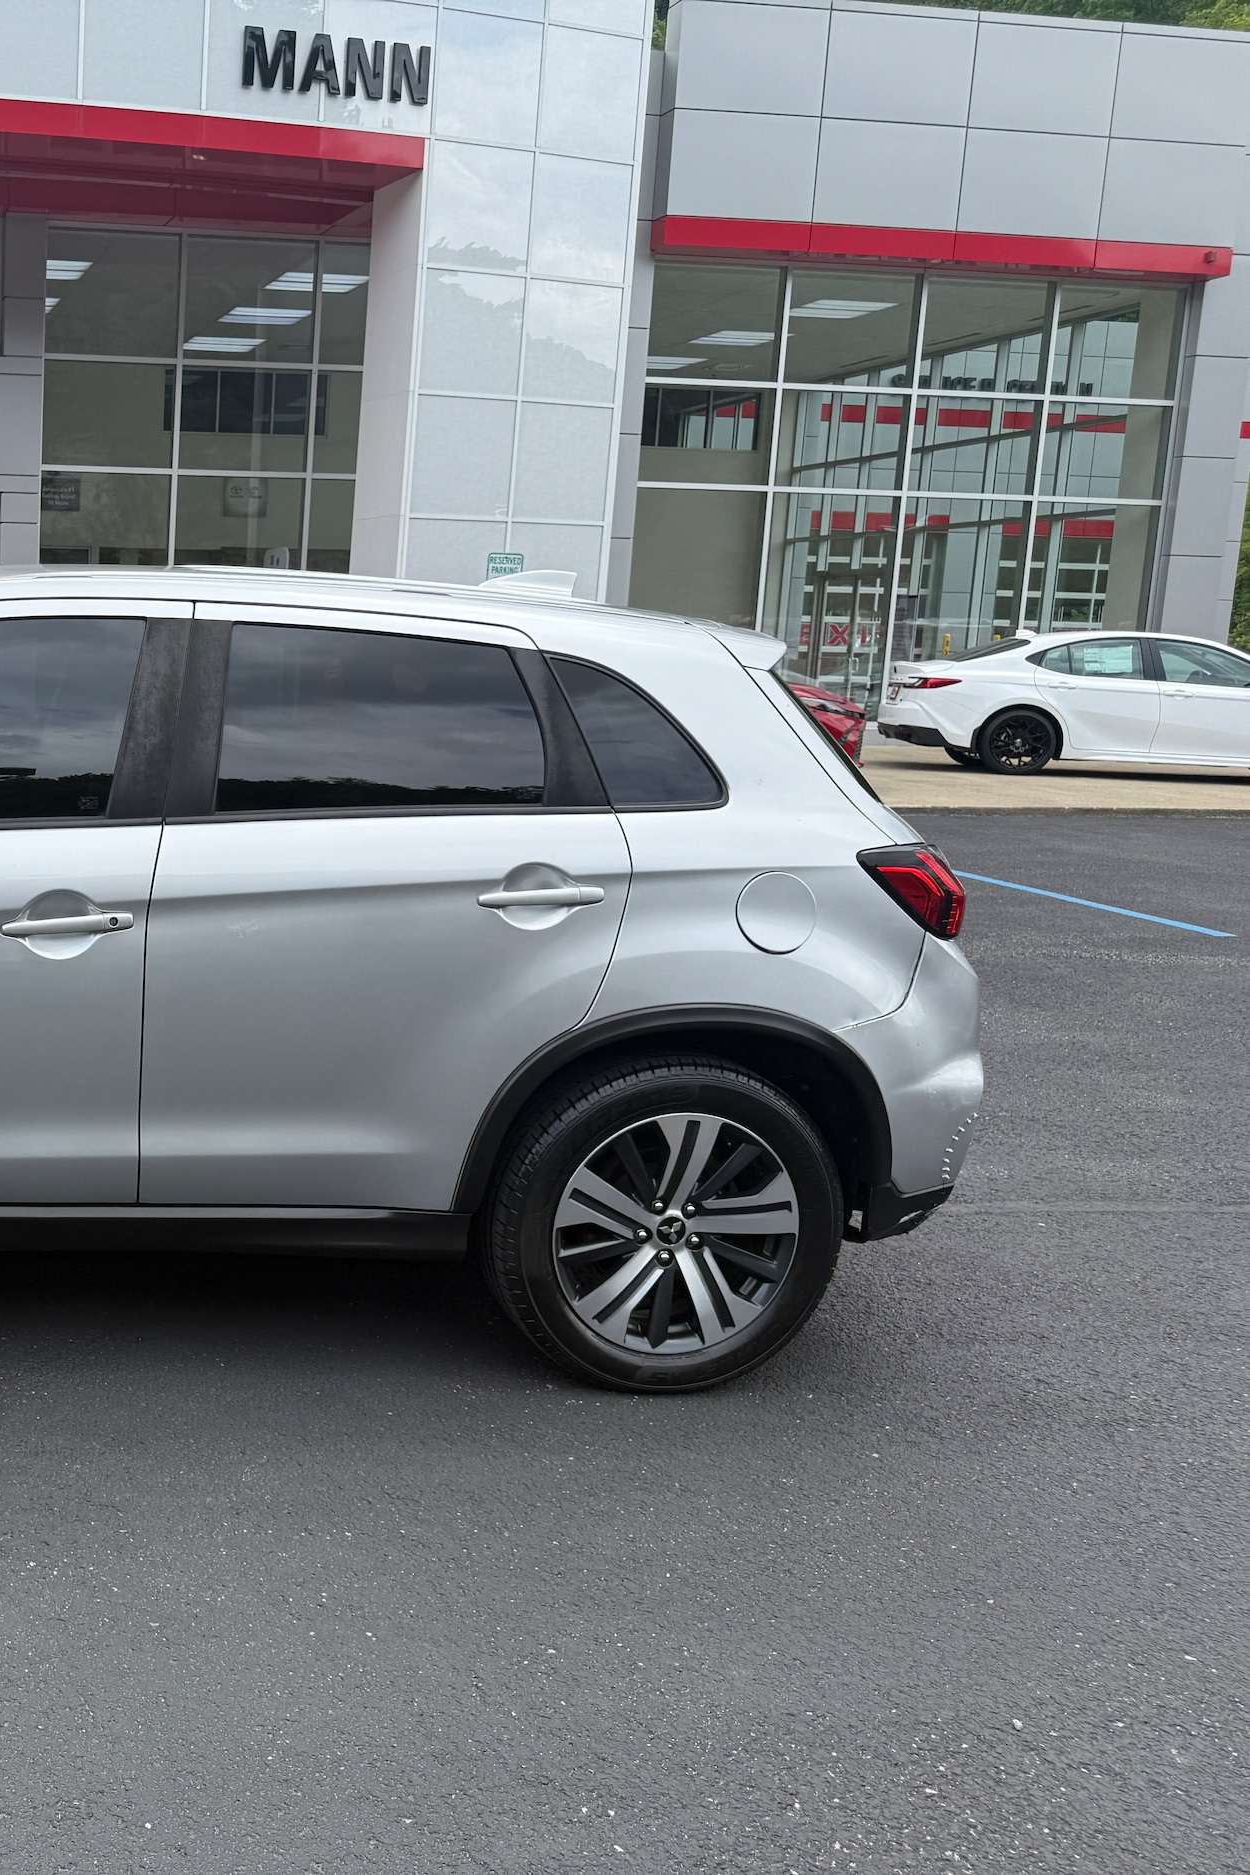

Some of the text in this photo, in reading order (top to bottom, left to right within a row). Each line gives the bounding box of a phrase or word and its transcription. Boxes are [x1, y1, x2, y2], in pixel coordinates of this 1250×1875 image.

[241, 25, 432, 105] MANN
[490, 556, 521, 565] RESERVED
[491, 566, 519, 575] PARKING
[799, 623, 880, 645] EXI
